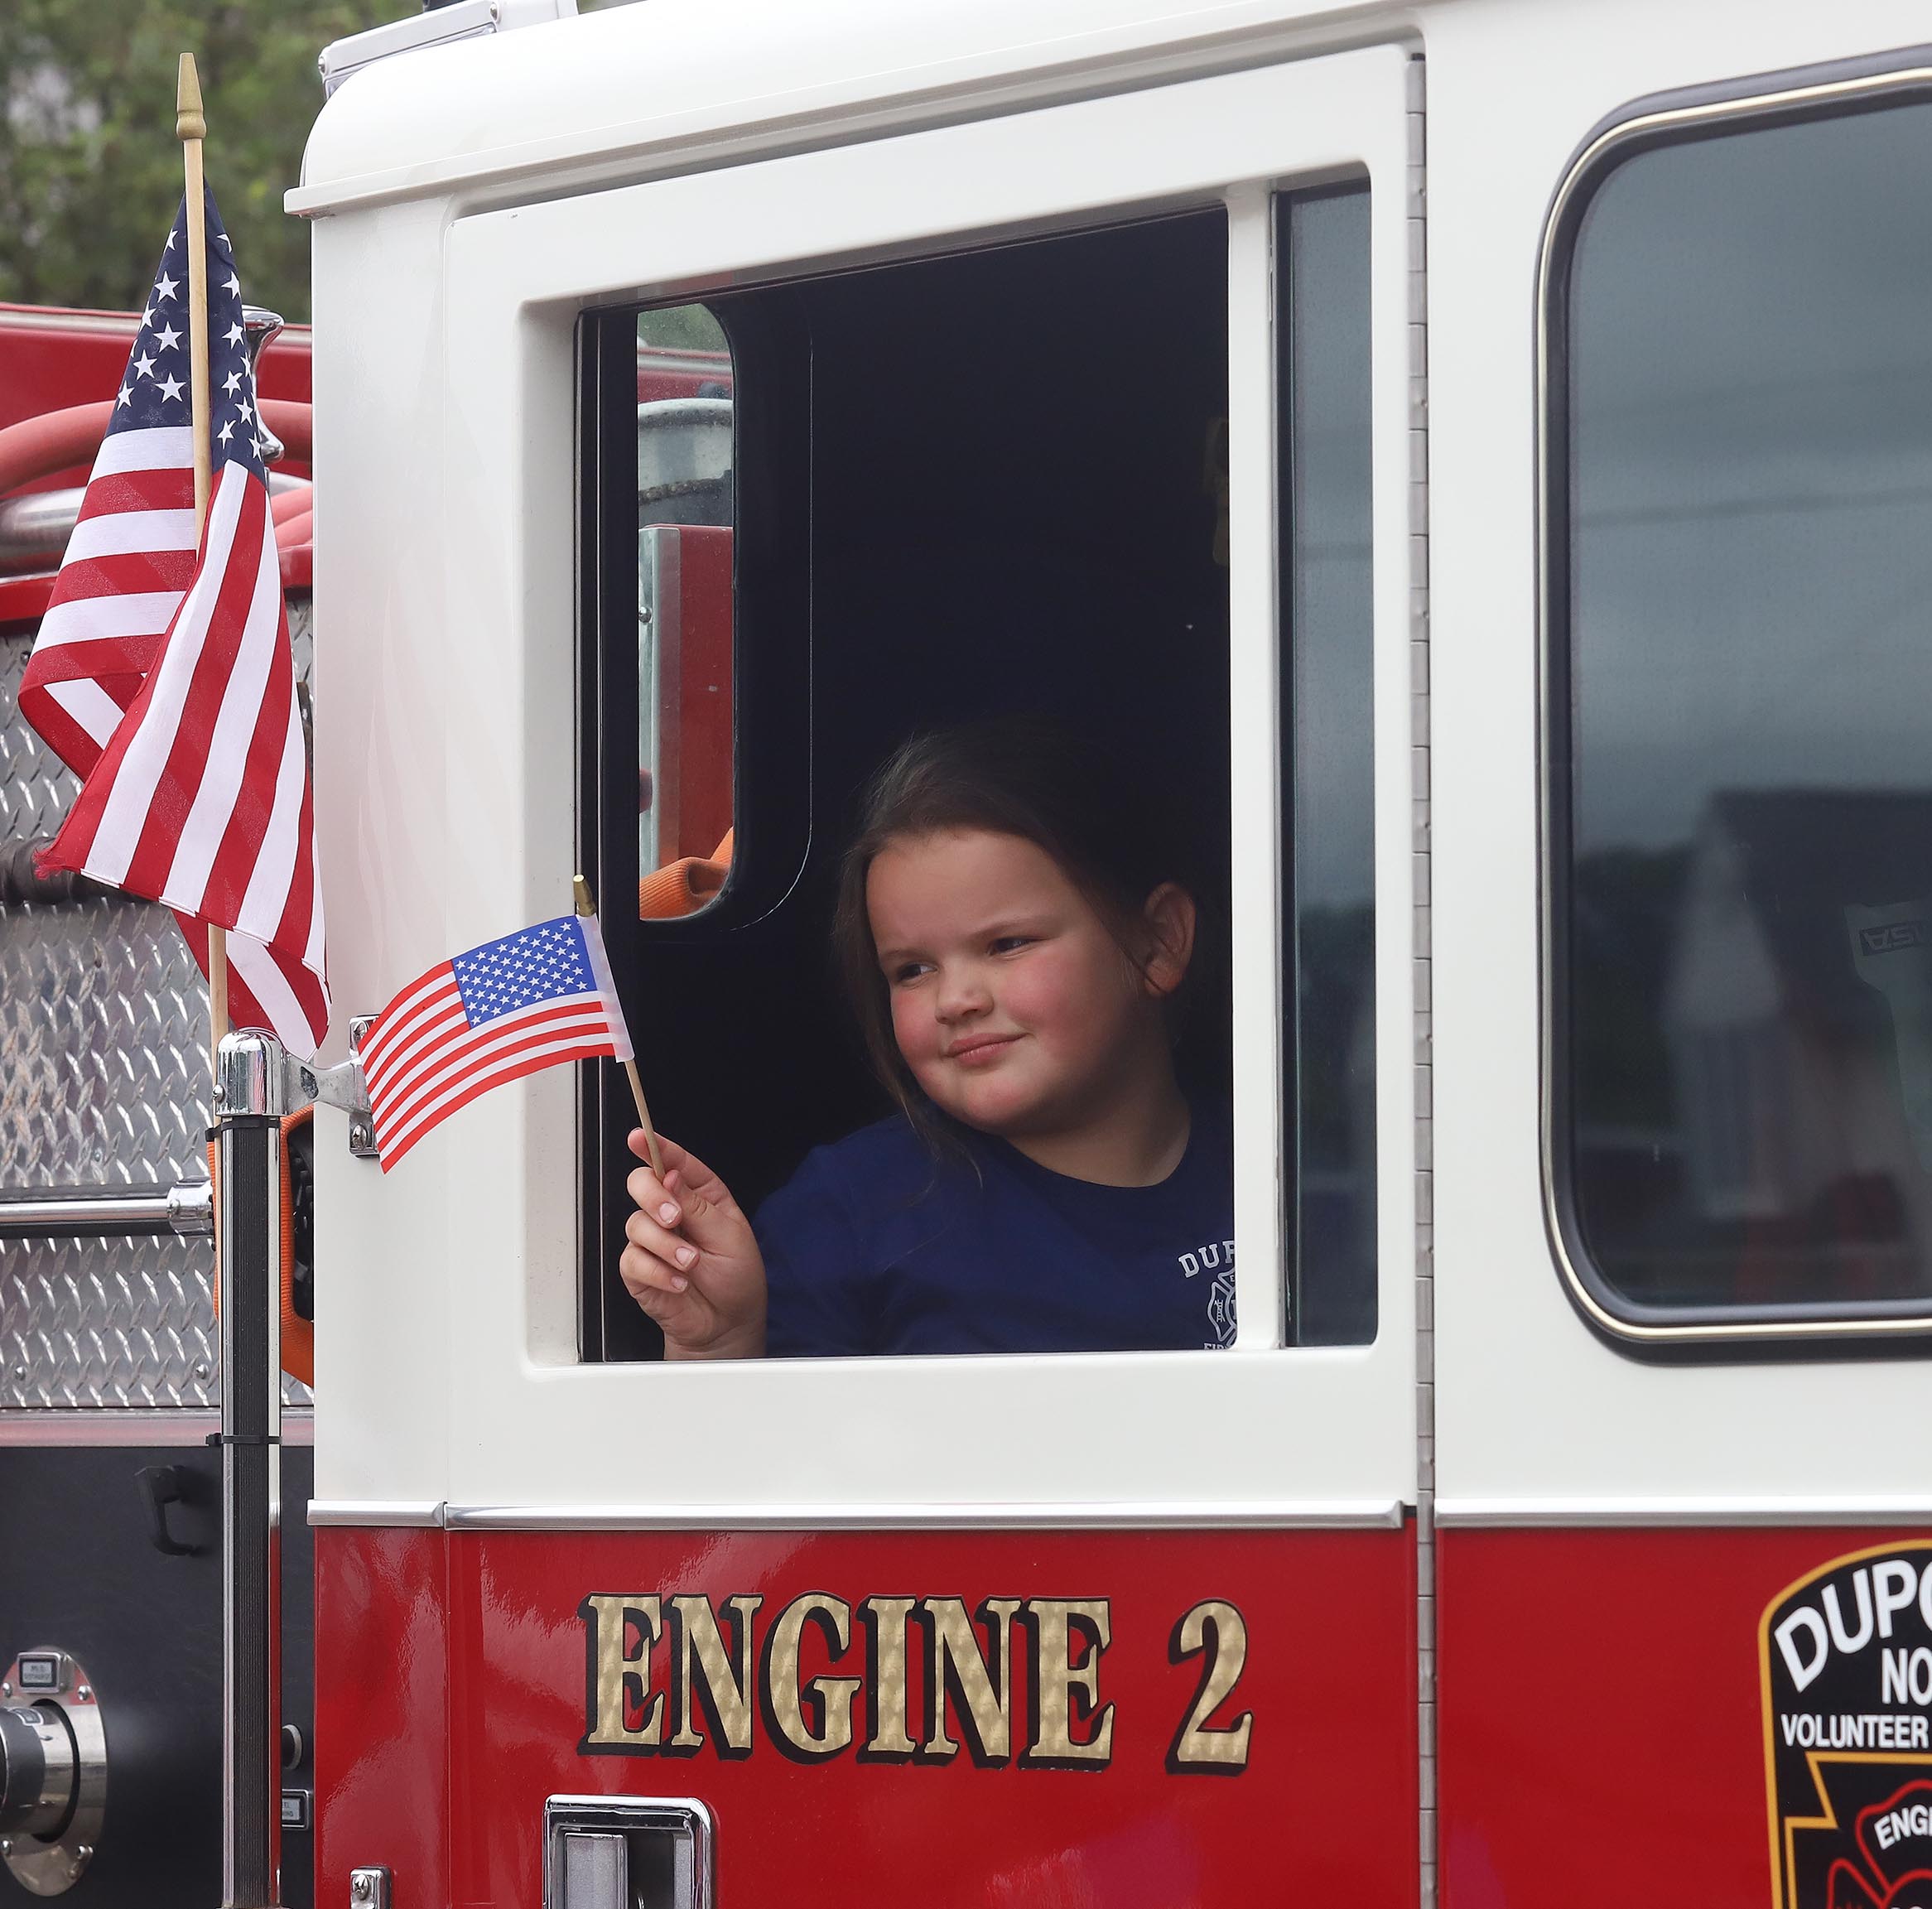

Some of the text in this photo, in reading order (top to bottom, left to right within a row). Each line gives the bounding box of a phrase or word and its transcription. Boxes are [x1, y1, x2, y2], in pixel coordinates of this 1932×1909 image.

[578, 1591, 1254, 1776] ENGINE 2
[1780, 1714, 1930, 1749] VOLUNTEER
